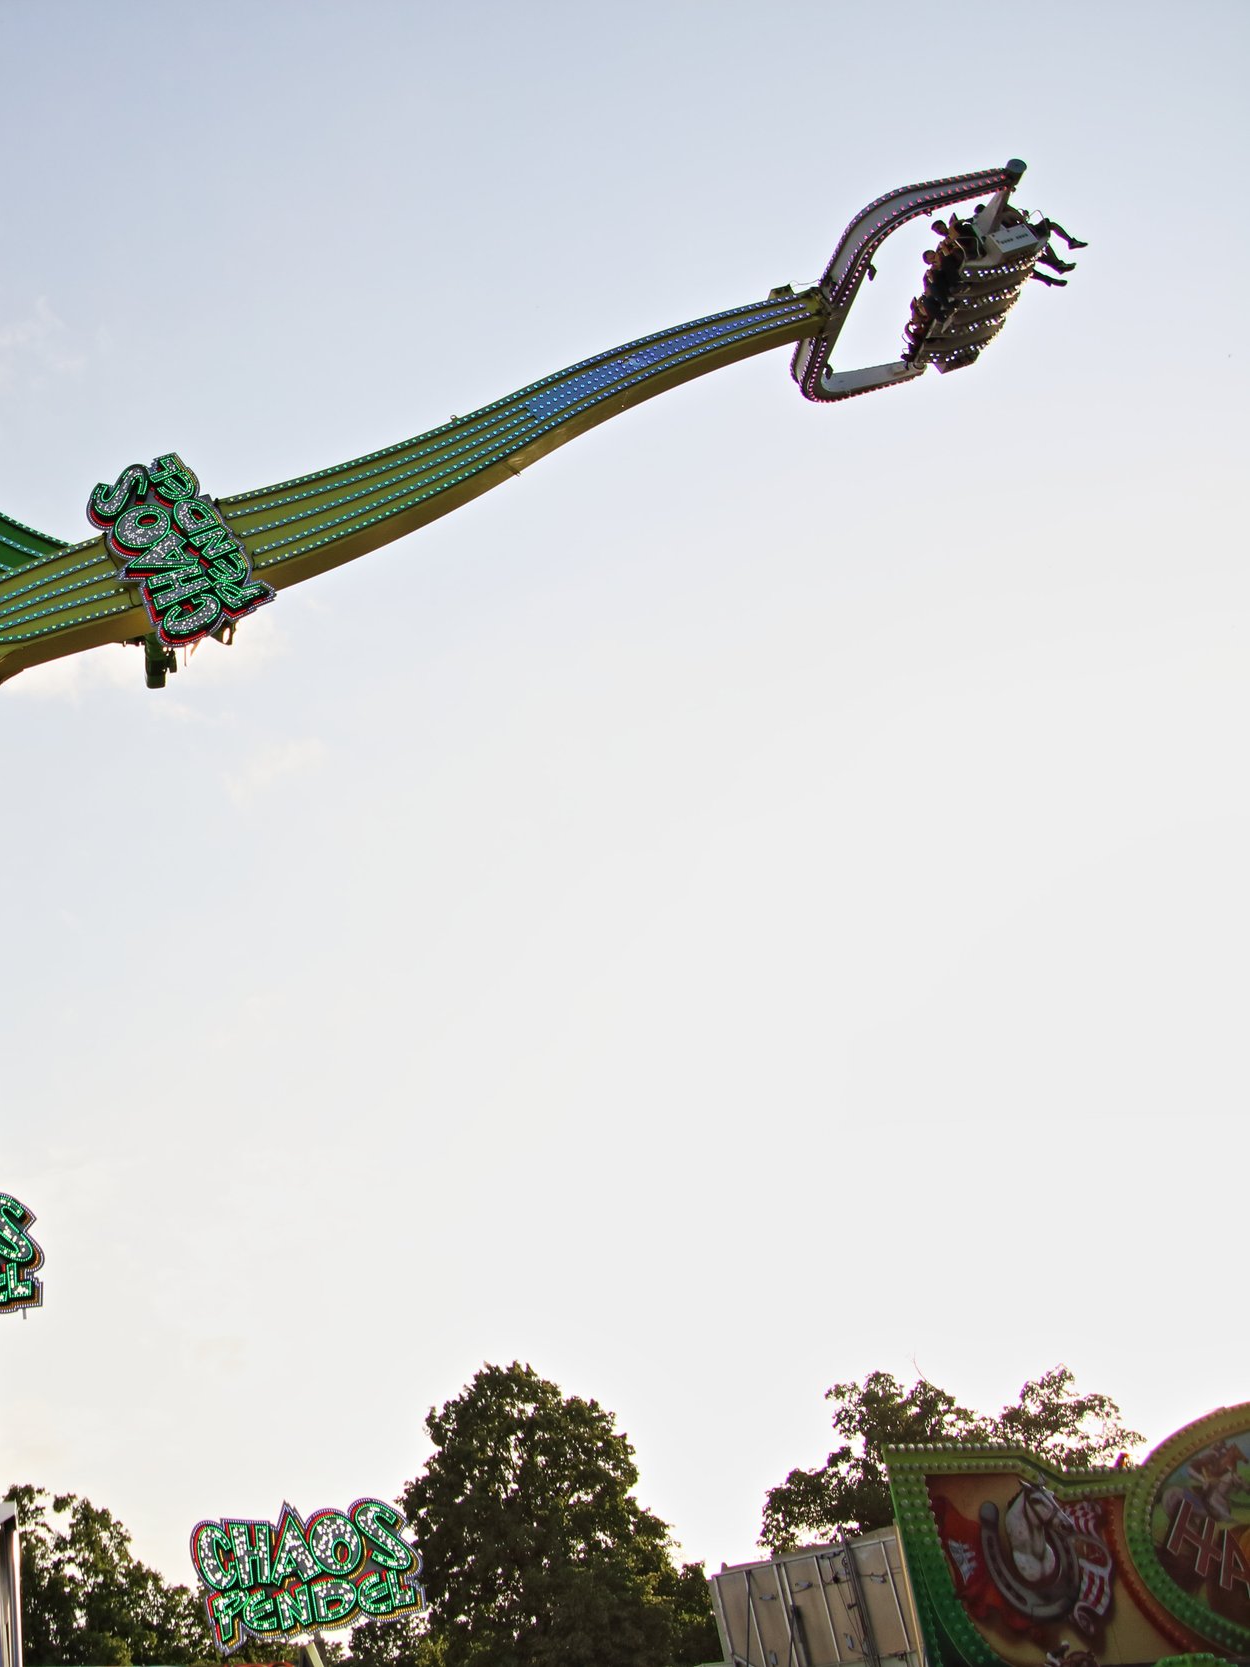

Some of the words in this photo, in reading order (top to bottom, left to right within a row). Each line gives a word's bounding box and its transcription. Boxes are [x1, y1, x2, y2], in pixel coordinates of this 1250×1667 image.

[90, 464, 221, 636] CHAOS
[150, 455, 271, 609] PENDEL
[197, 1502, 411, 1590] CHAOS
[210, 1570, 416, 1642] PENDEL
